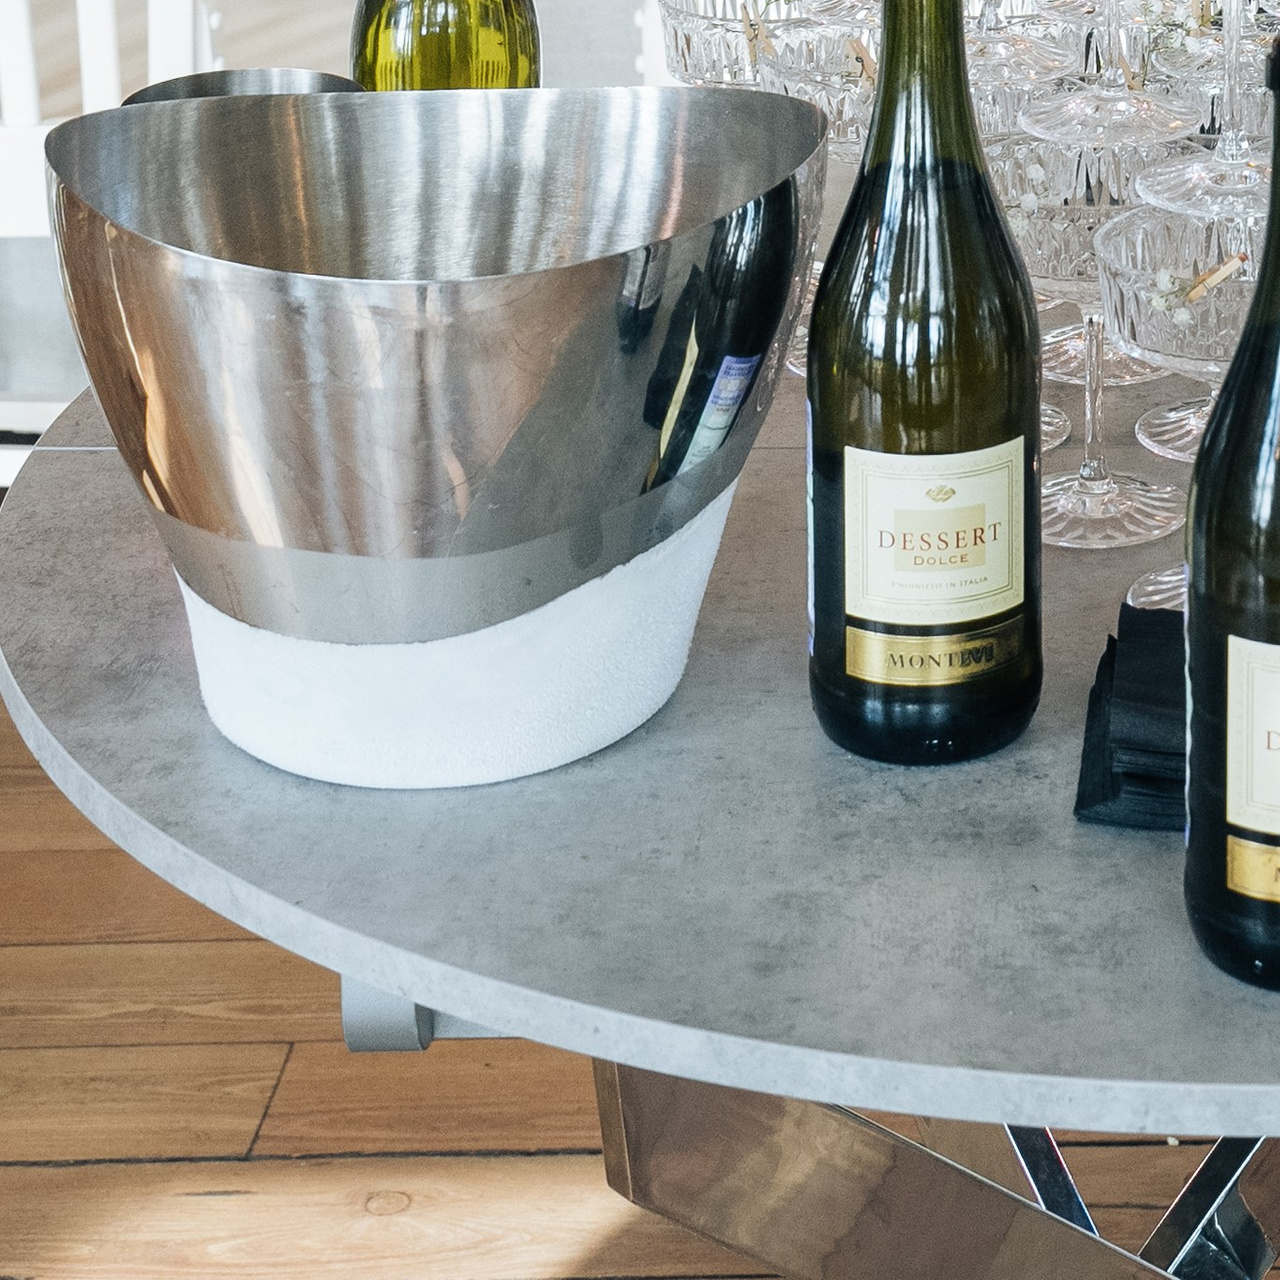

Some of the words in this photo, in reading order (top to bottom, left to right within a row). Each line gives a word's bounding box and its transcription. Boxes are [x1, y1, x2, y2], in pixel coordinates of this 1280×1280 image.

[879, 522, 1001, 551] DESSERT
[913, 554, 969, 567] DOLCE
[960, 576, 989, 588] ITALIA
[886, 642, 995, 669] MONTEVI
